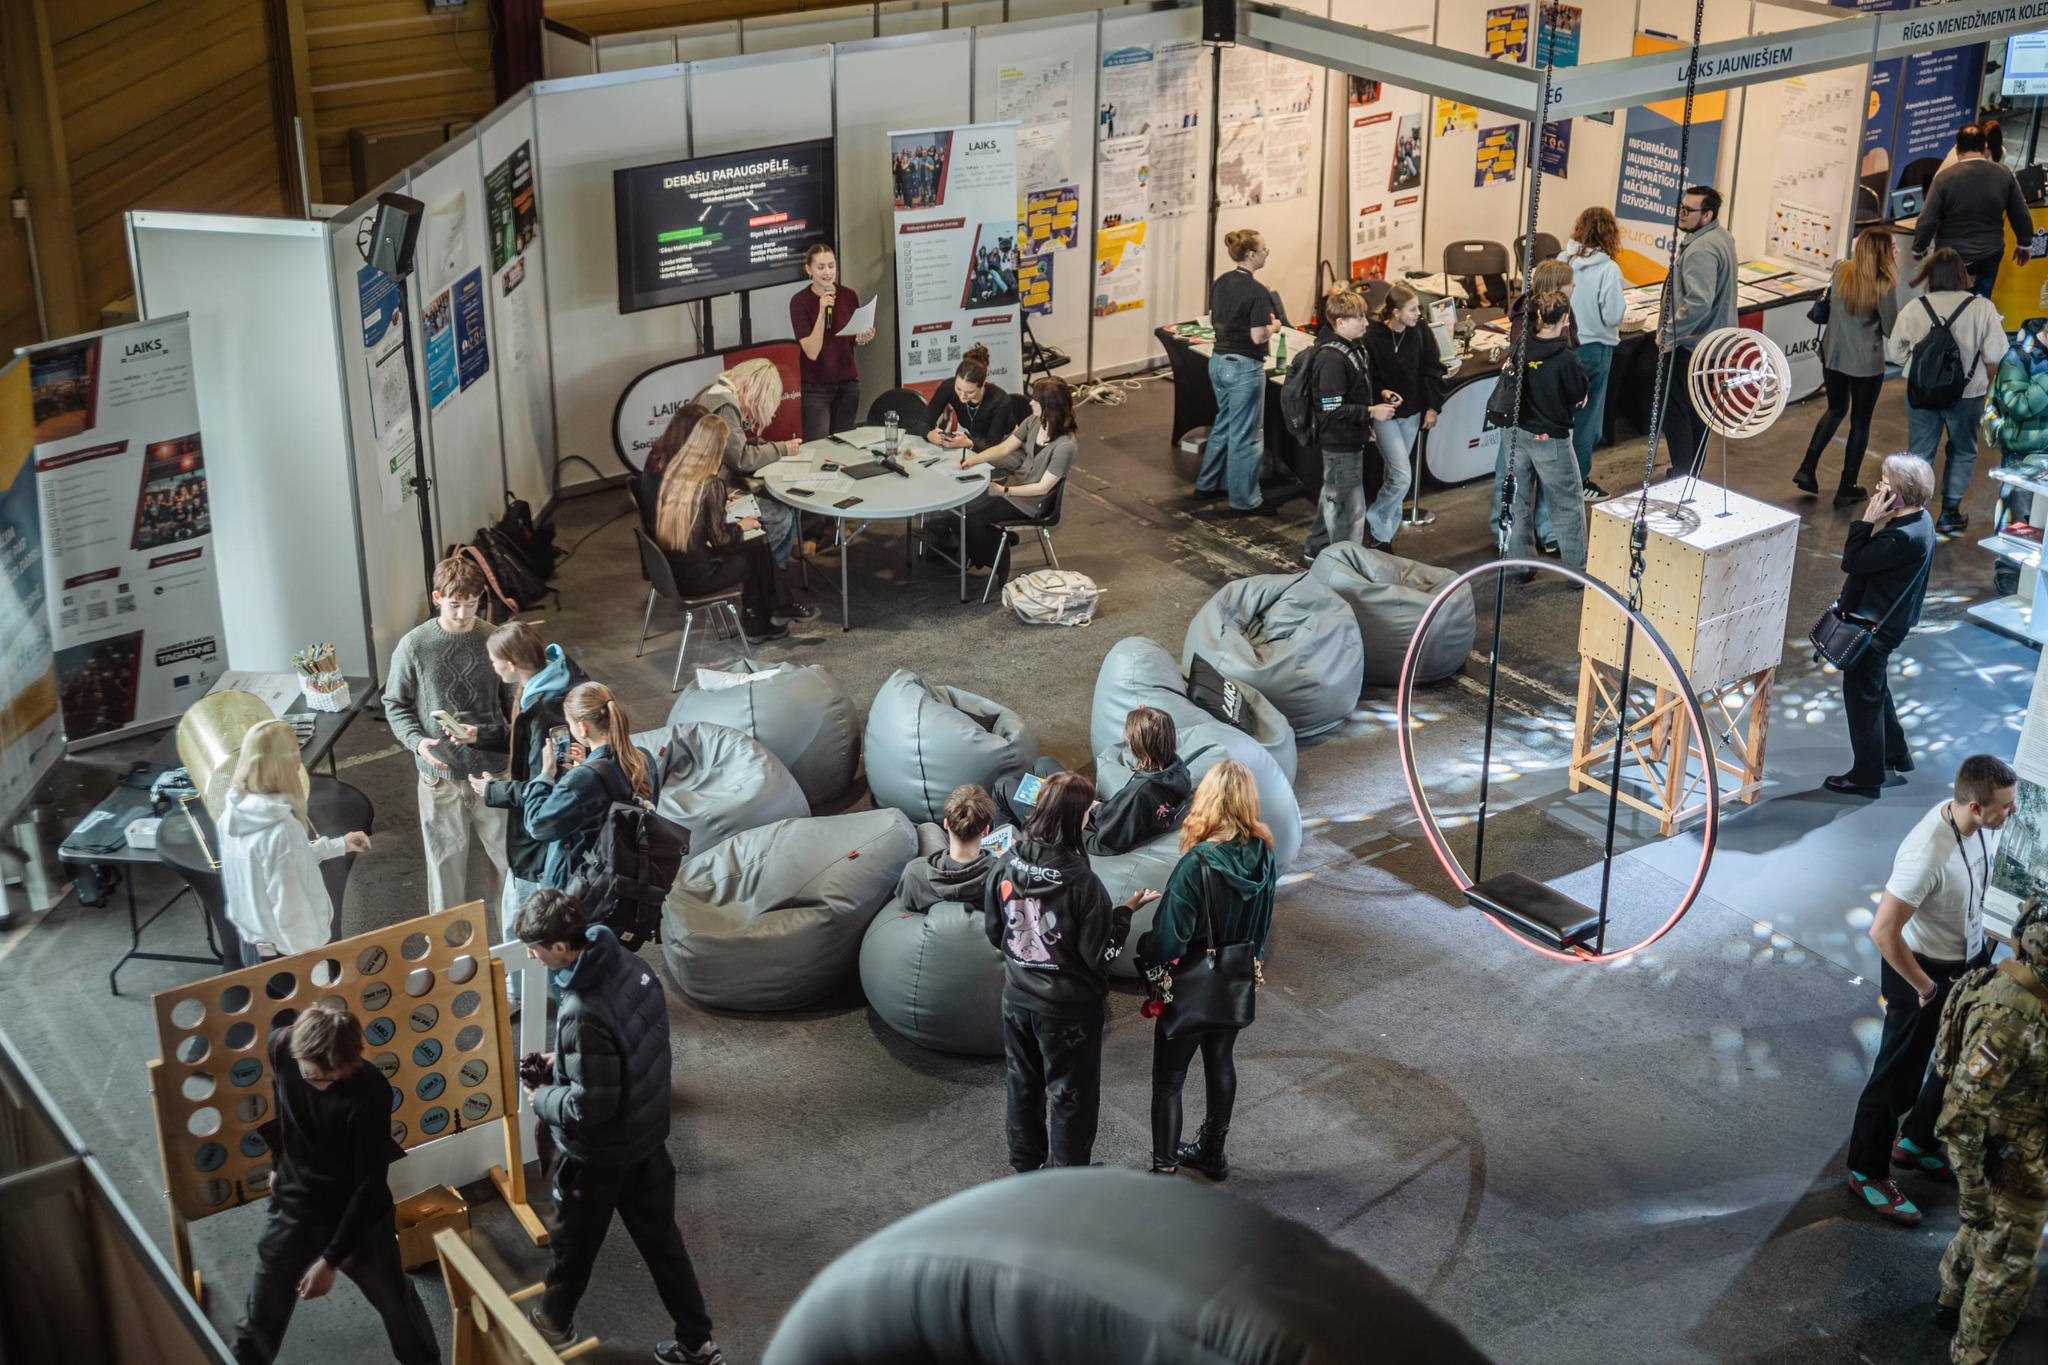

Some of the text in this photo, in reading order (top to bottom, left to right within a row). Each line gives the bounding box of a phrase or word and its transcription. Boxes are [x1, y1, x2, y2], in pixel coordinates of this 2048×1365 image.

[1902, 22, 1934, 42] RĪGAS
[1936, 9, 2016, 36] MENEDŽMENTA
[1677, 47, 1793, 83] LAKS JAUNIEŠIEM
[969, 140, 997, 151] LAIKS
[1628, 137, 1678, 160] INFORMĀCIJA
[1626, 152, 1672, 173] JAUNIEŠIEM
[663, 159, 789, 189] DEBAŠU PARAUGSPĒLE
[1625, 165, 1675, 188] BRĪVPRĀTĪGO
[1623, 179, 1662, 200] MĀCĪBĀM,
[1621, 193, 1665, 214] DZĪVOŠANU
[125, 338, 162, 356] LAIKS
[1785, 338, 1818, 357] LAIKS
[158, 643, 215, 664] TAGADNE
[1221, 679, 1237, 718] LAIKS
[373, 1022, 390, 1038] LAIKS
[420, 1043, 436, 1059] LAIKS
[420, 1077, 439, 1094] LAIKS
[424, 1112, 444, 1124] LAIKS
